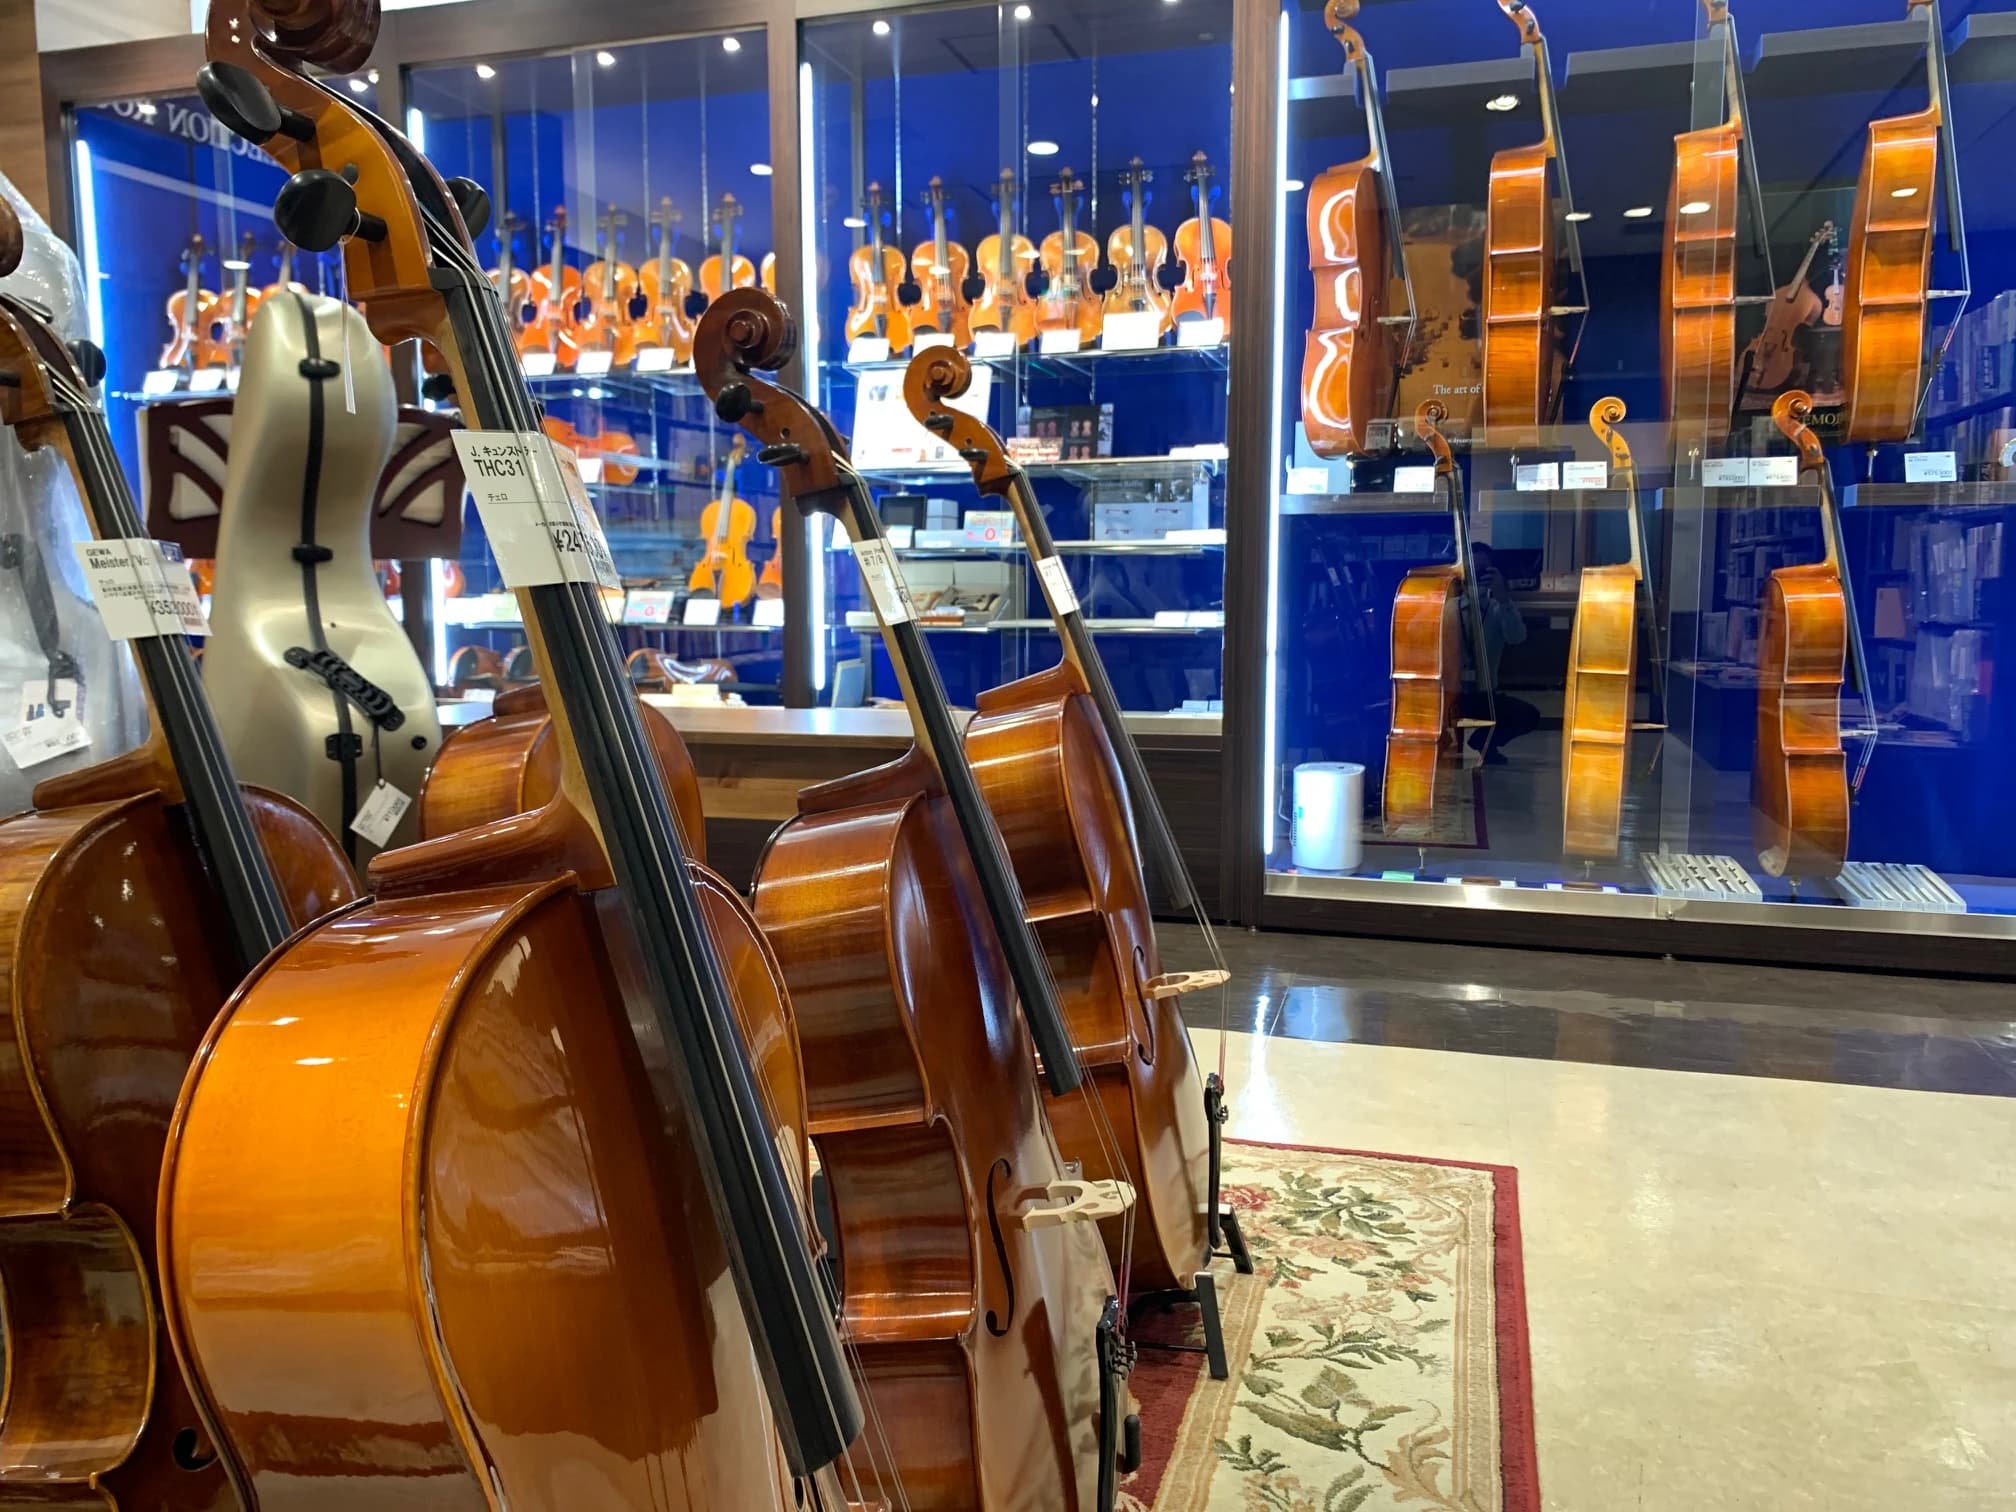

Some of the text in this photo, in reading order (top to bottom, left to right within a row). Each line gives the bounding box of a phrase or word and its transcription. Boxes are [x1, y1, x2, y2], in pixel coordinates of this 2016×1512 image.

[1433, 383, 1482, 395] The art of
[1799, 413, 1842, 426] EMO
[470, 446, 480, 457] J.
[473, 459, 525, 478] THC31
[487, 493, 508, 501] チェロ
[86, 548, 111, 557] GEWA
[89, 557, 129, 569] Meister
